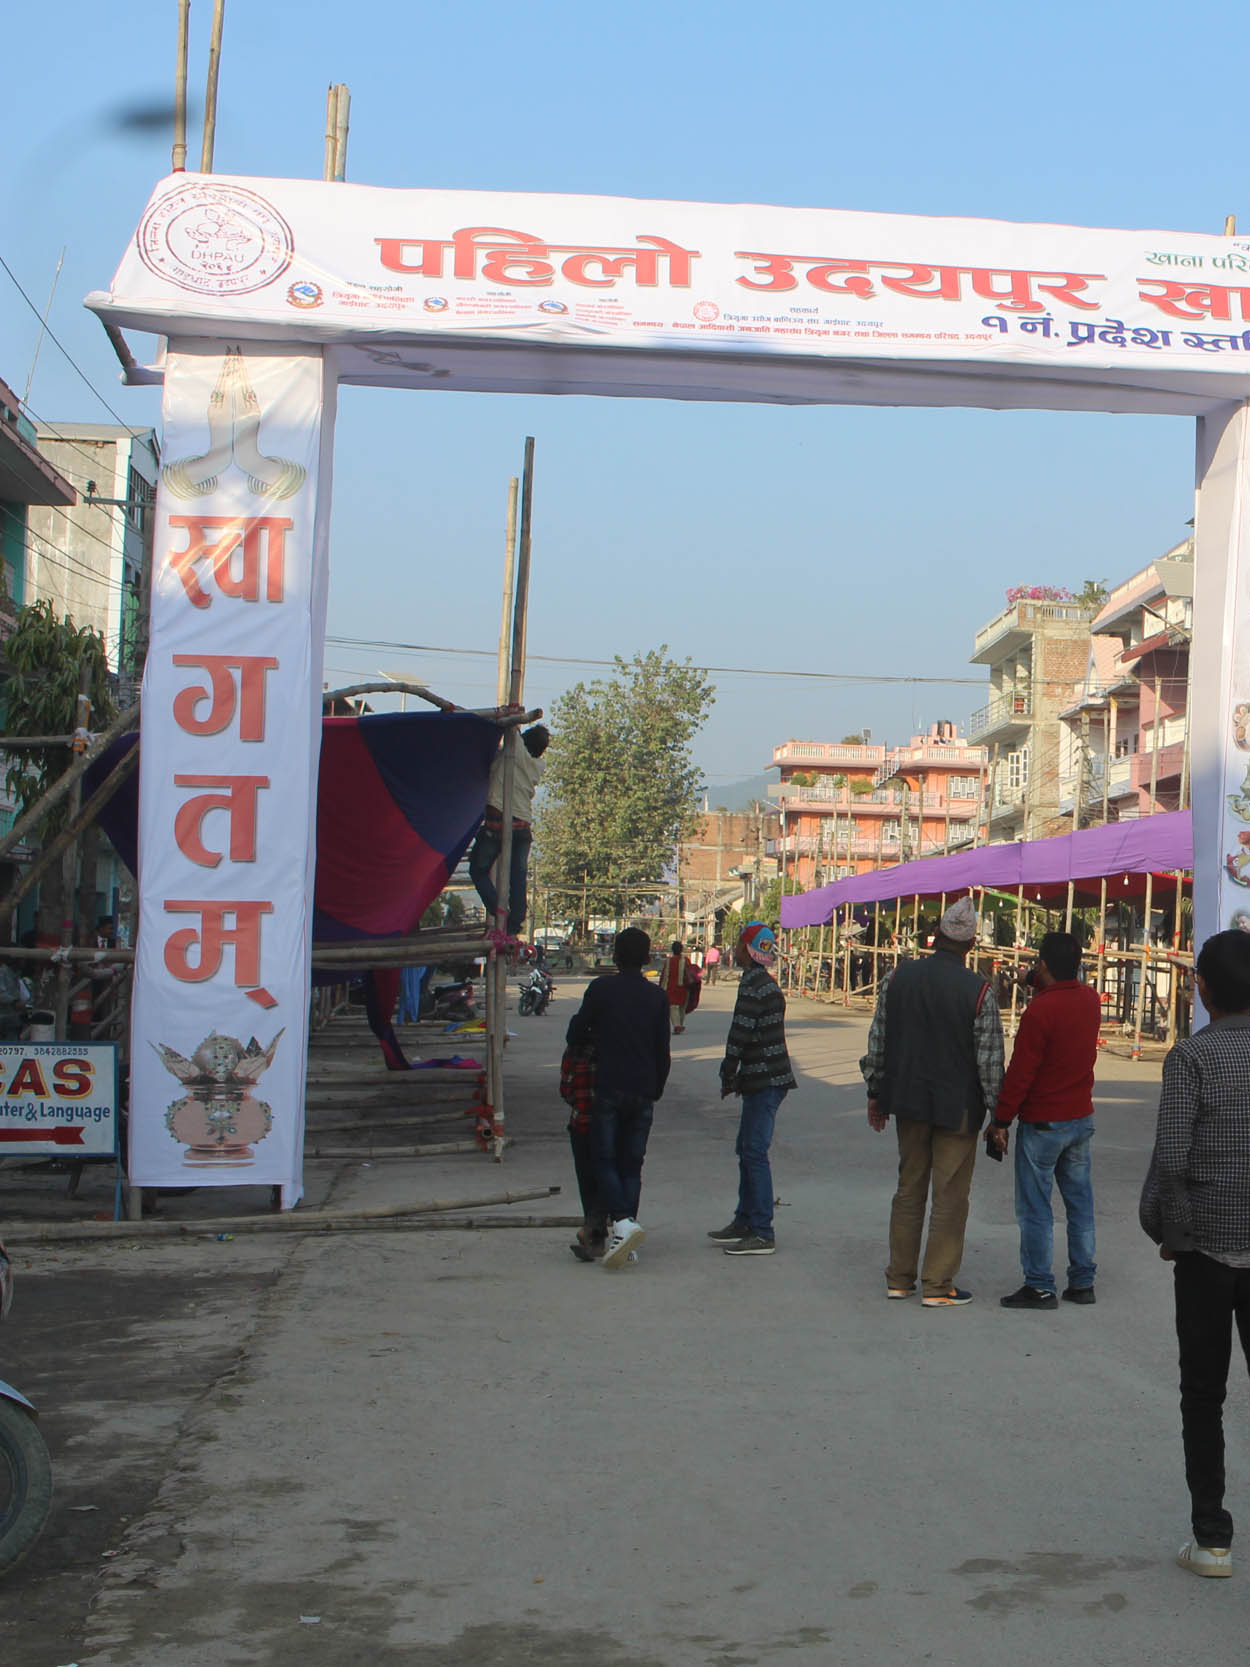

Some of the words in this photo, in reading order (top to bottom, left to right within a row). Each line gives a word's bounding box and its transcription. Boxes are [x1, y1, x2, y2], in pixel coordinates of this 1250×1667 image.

[373, 226, 701, 288] पहिलो
[735, 251, 1107, 313] उदयपुर
[1145, 251, 1203, 268] खाना
[981, 315, 1009, 333] १
[1066, 318, 1173, 349] प्रदेश
[40, 1102, 110, 1122] Language
